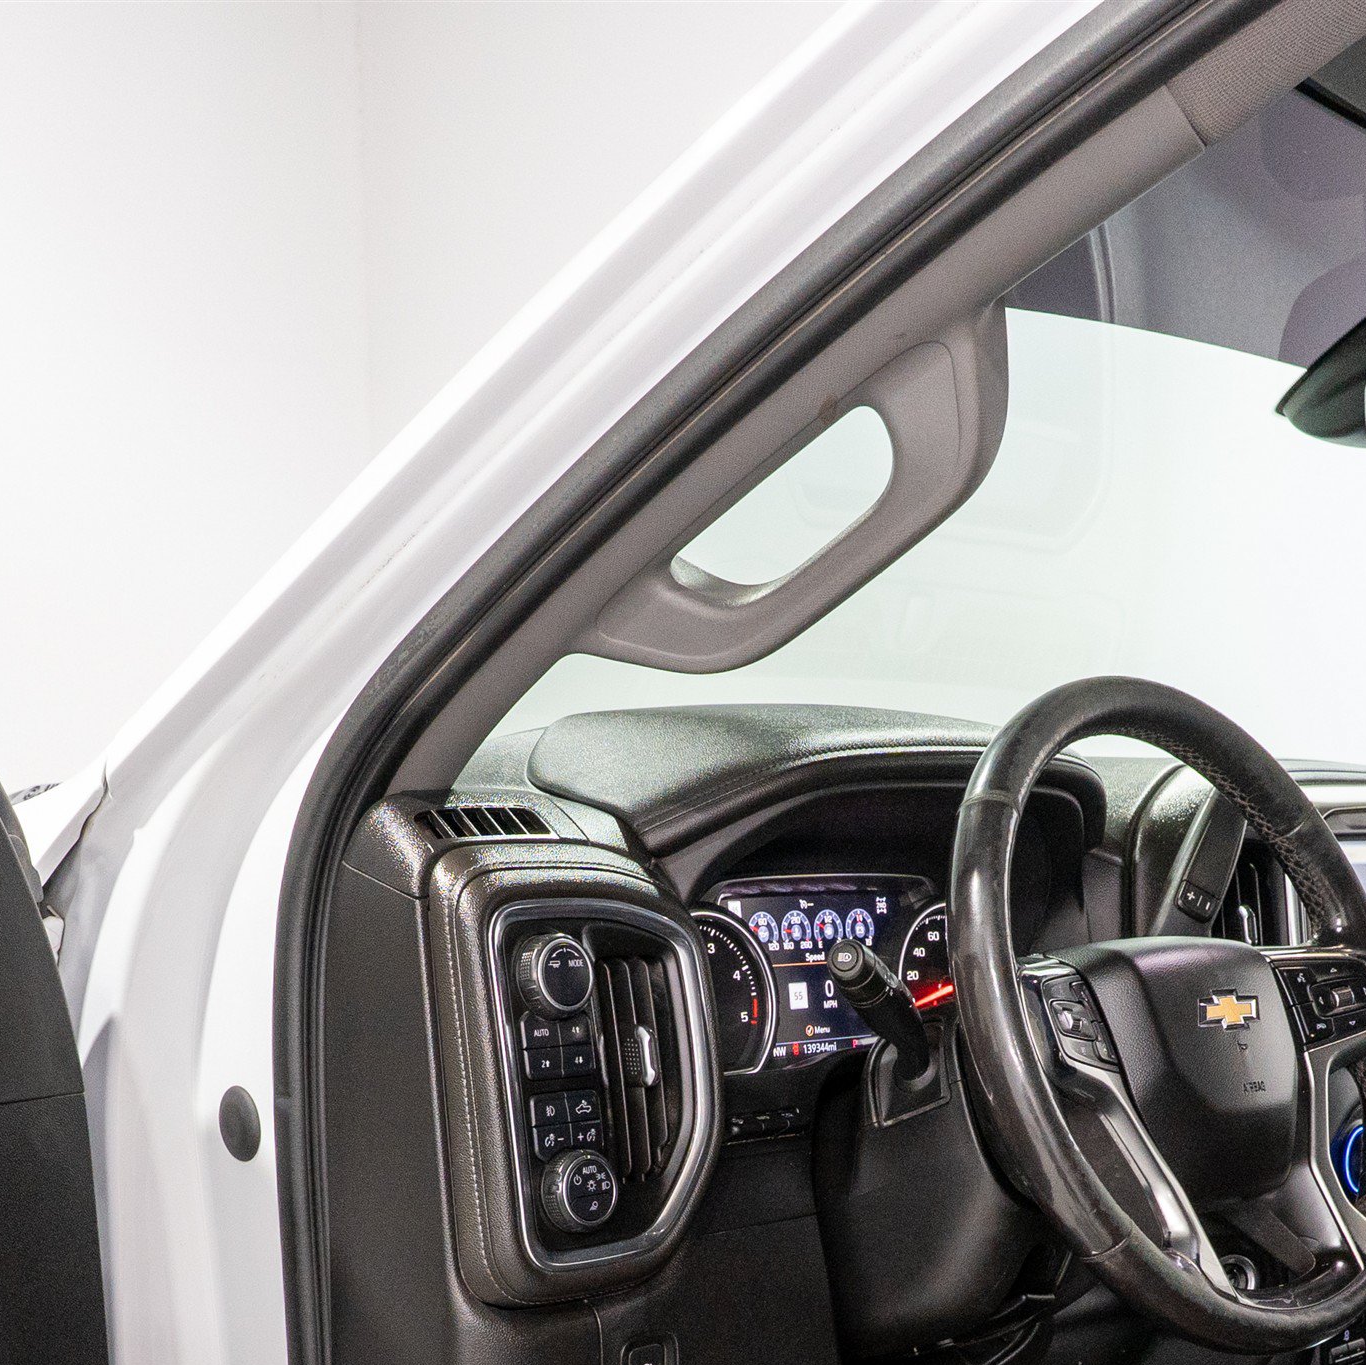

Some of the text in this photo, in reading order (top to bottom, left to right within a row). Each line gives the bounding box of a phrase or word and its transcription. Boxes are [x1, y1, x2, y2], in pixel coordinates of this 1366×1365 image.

[927, 931, 940, 941] 60
[707, 943, 715, 954] 3
[913, 947, 926, 957] 40
[805, 951, 826, 963] Speed
[568, 959, 584, 967] MODE
[733, 970, 742, 981] 4
[907, 971, 919, 980] 20
[825, 980, 834, 997] 0
[823, 1000, 838, 1009] MPH
[740, 1011, 749, 1022] 5
[534, 1028, 549, 1037] AUTO
[814, 1026, 831, 1034] Menu
[773, 1046, 786, 1057] NW
[582, 1165, 597, 1175] AUTO
